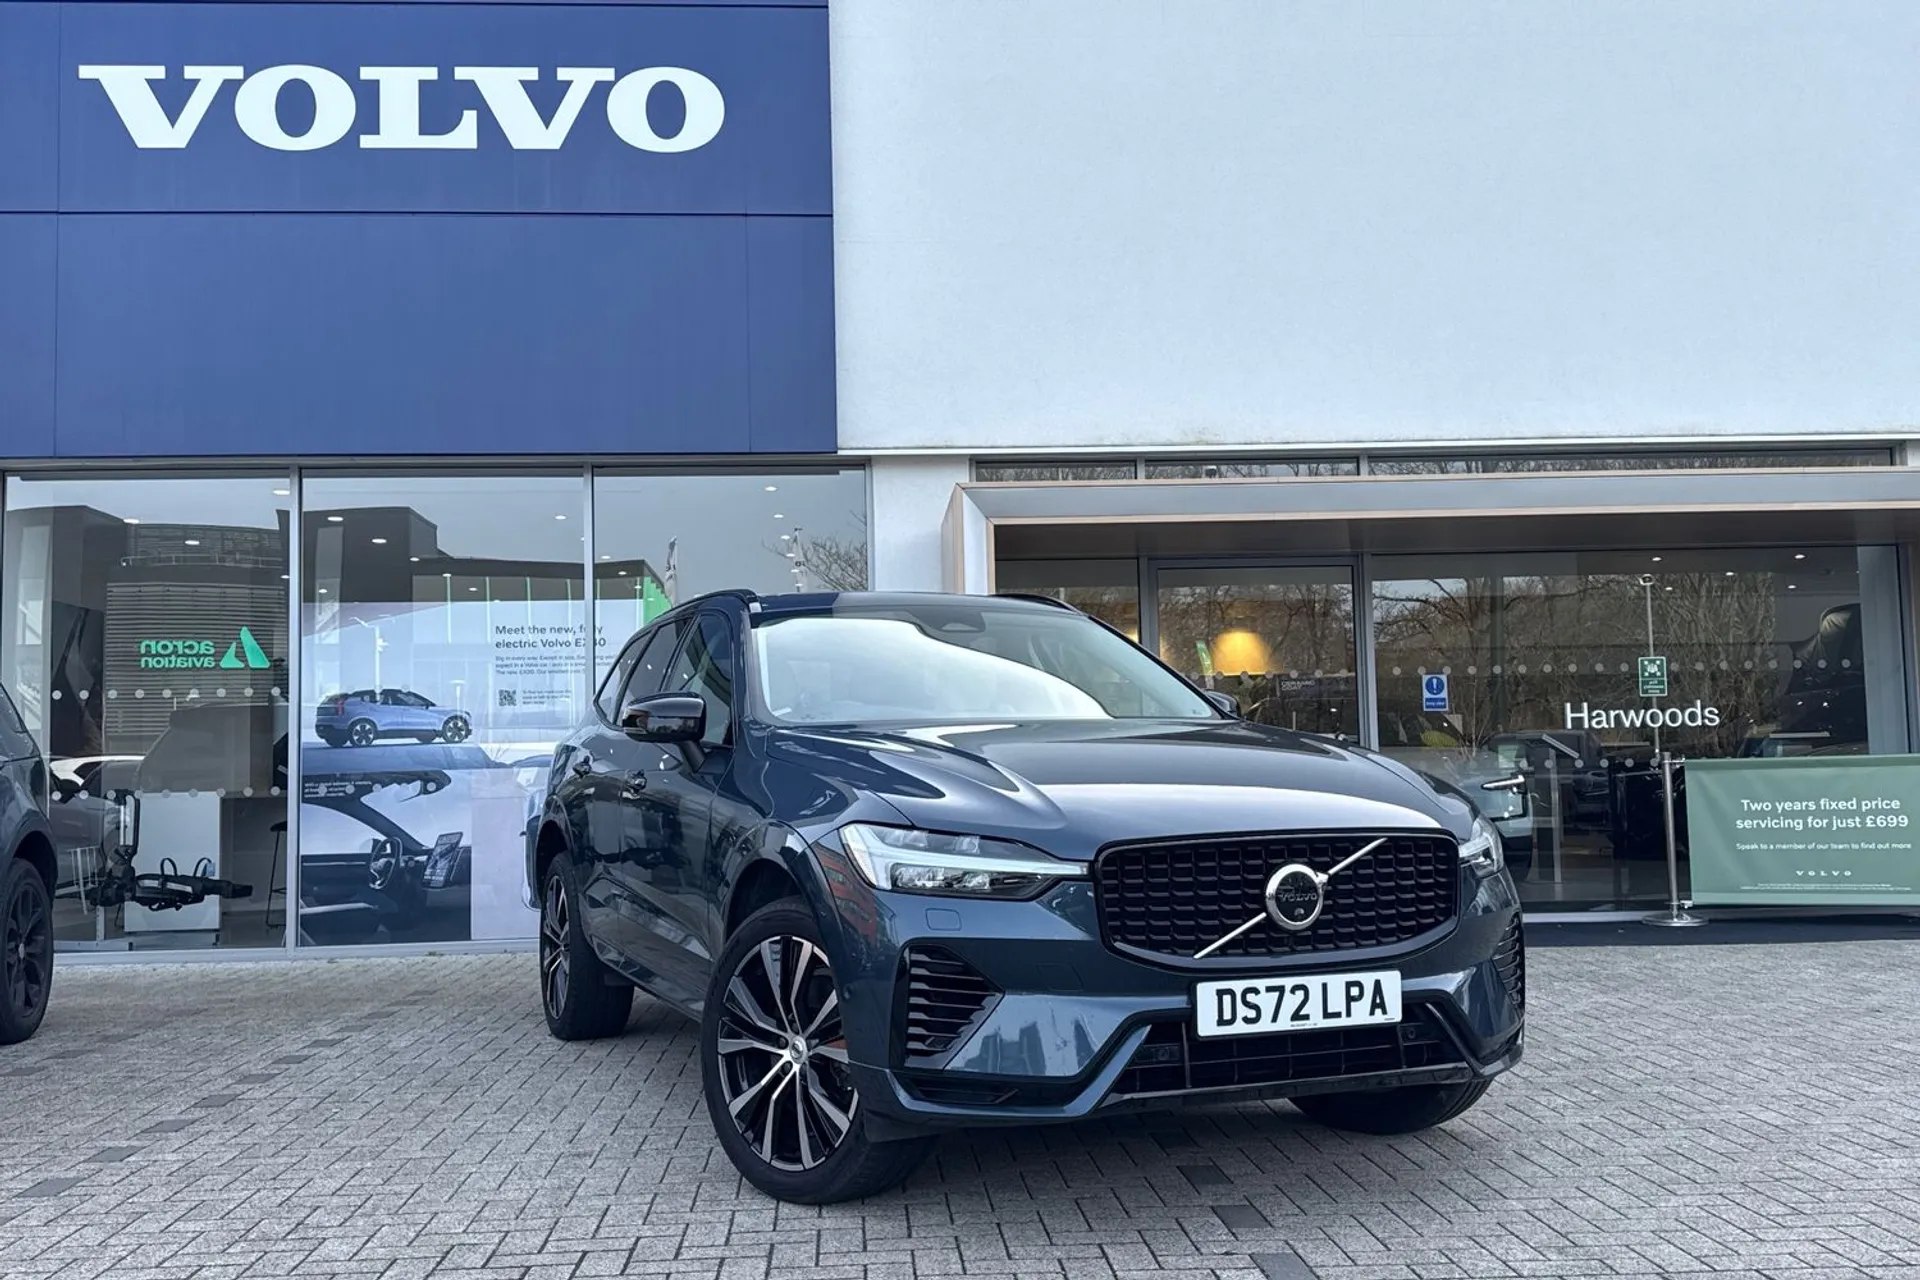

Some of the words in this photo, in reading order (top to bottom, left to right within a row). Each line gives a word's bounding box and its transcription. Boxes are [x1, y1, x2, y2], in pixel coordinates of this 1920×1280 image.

[78, 64, 726, 153] VOLVO
[495, 625, 526, 635] Meet
[528, 624, 547, 634] the
[549, 626, 577, 636] new,
[495, 638, 538, 649] electric
[540, 638, 572, 648] Volvo
[1564, 699, 1720, 729] Harwoods
[1741, 799, 1772, 811] Two
[1775, 801, 1817, 813] years
[1819, 797, 1857, 810] fixed
[1861, 797, 1901, 812] price
[1735, 816, 1804, 831] servicing
[1807, 816, 1829, 828] for
[1832, 815, 1862, 830] just
[1865, 815, 1909, 828] £699
[1807, 842, 1815, 850] of
[1277, 893, 1318, 902] VOLVO
[1215, 984, 1310, 1027] DS72
[1321, 979, 1388, 1020] LPA
